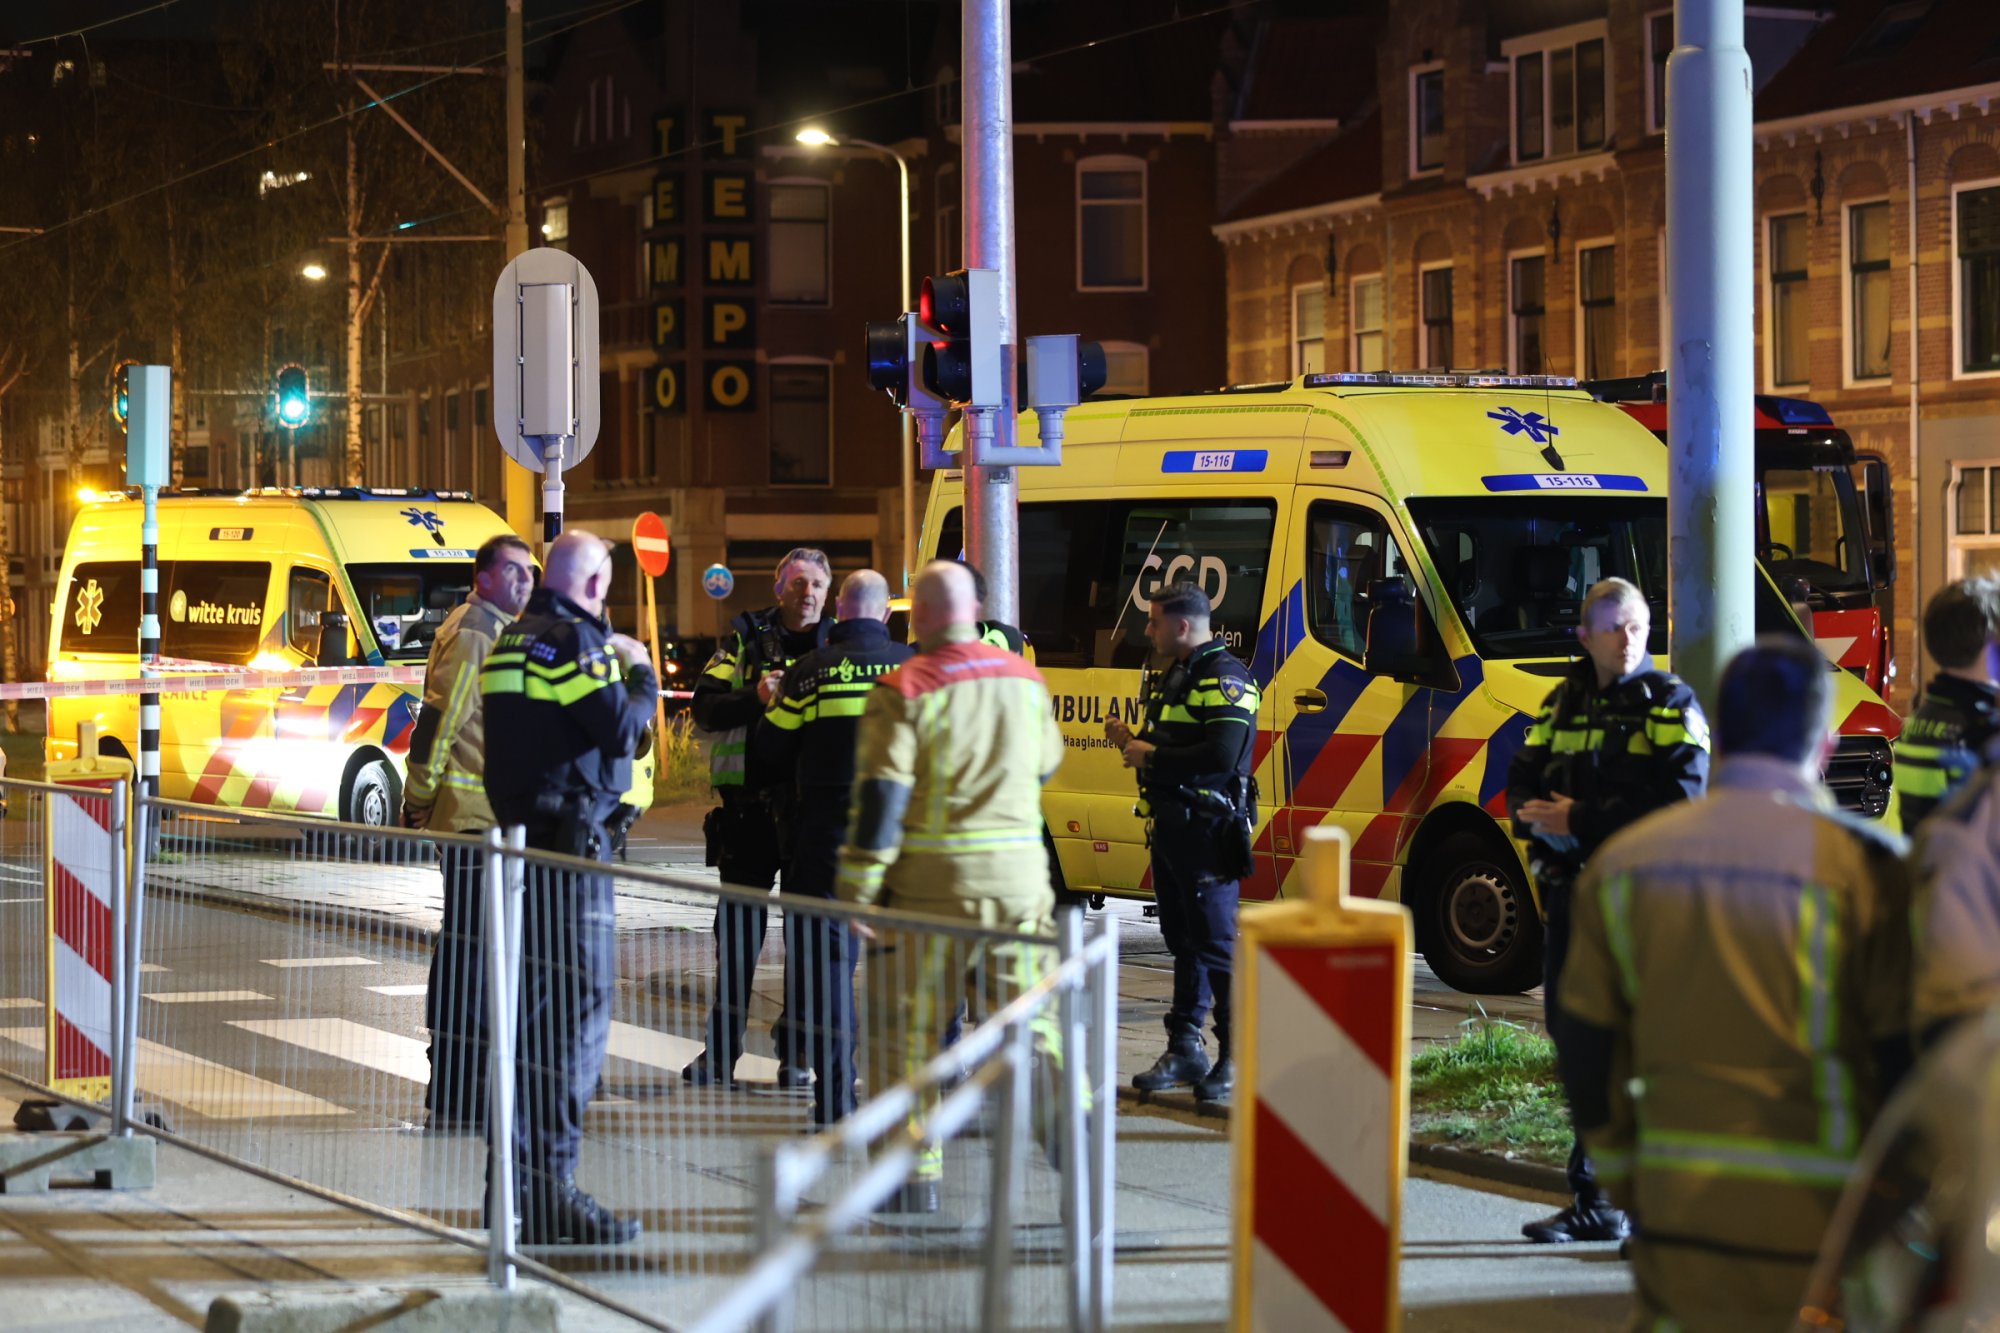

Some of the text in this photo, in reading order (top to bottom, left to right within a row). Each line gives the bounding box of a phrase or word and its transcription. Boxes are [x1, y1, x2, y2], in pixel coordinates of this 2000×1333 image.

[656, 118, 678, 408] TEMPO
[710, 115, 750, 406] TEMPO
[1200, 455, 1231, 468] 15-116
[1545, 476, 1594, 487] 15-116
[188, 600, 262, 626] witte kruis
